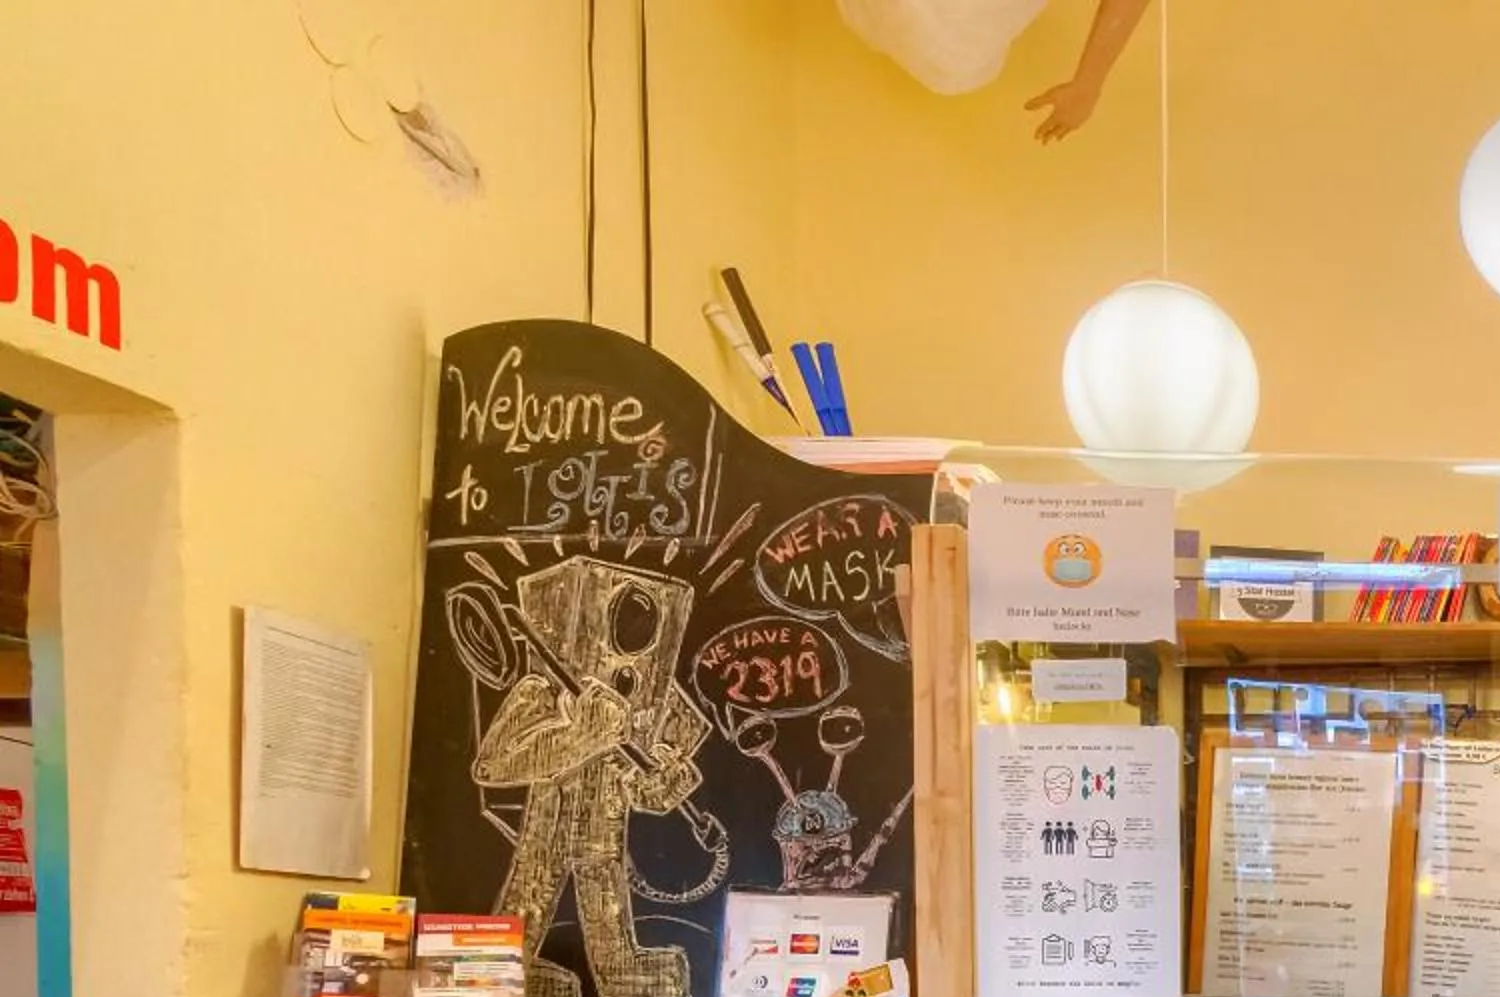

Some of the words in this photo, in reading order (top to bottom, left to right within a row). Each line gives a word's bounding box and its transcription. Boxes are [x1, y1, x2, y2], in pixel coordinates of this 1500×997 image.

[448, 345, 664, 453] Welcome
[445, 464, 488, 525] to
[877, 505, 897, 538] A
[785, 549, 897, 602] MASK
[701, 643, 731, 669] WE
[733, 627, 791, 649] HAVE
[801, 632, 819, 647] A
[721, 651, 822, 702] 2319
